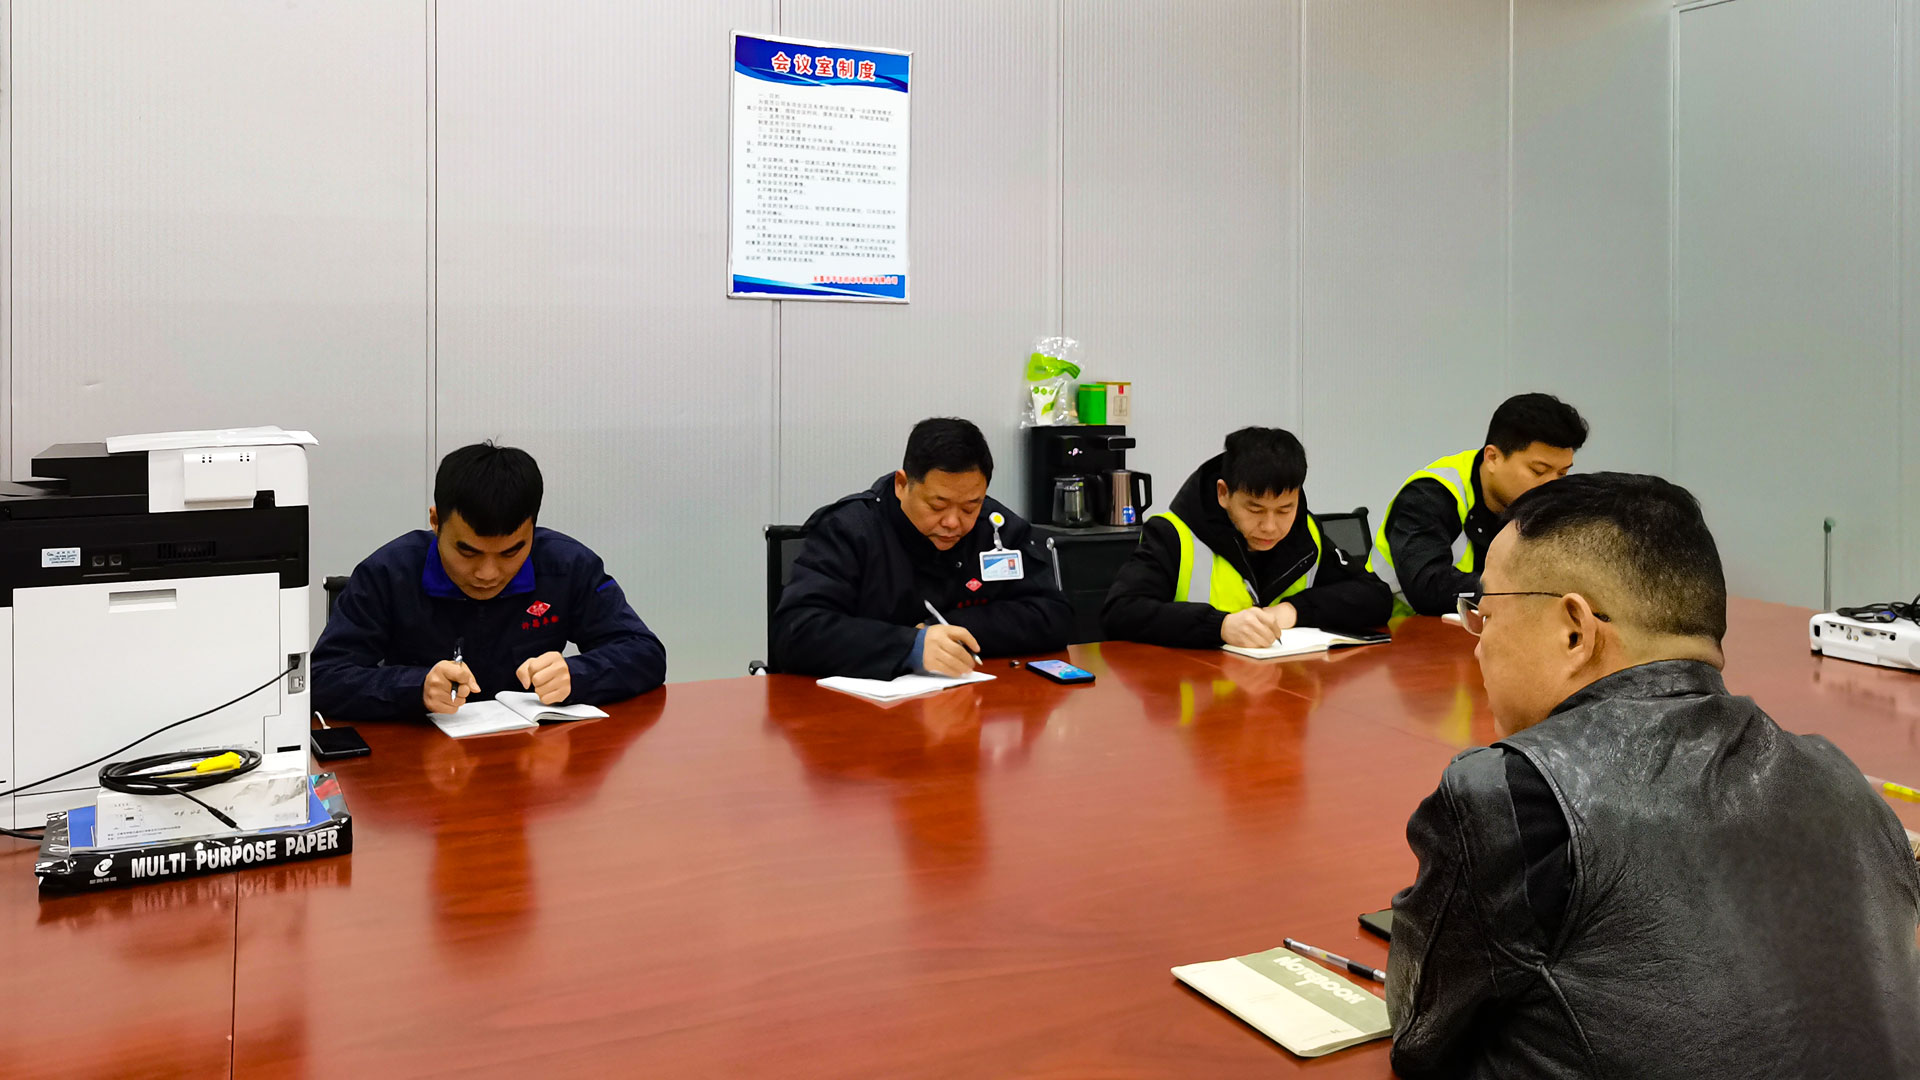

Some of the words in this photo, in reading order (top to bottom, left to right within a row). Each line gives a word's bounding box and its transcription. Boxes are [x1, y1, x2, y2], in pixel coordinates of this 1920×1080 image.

[772, 52, 875, 81] 会议室制度
[131, 852, 186, 878] MULTI
[196, 839, 277, 870] PURPOSE
[285, 829, 339, 857] PAPER
